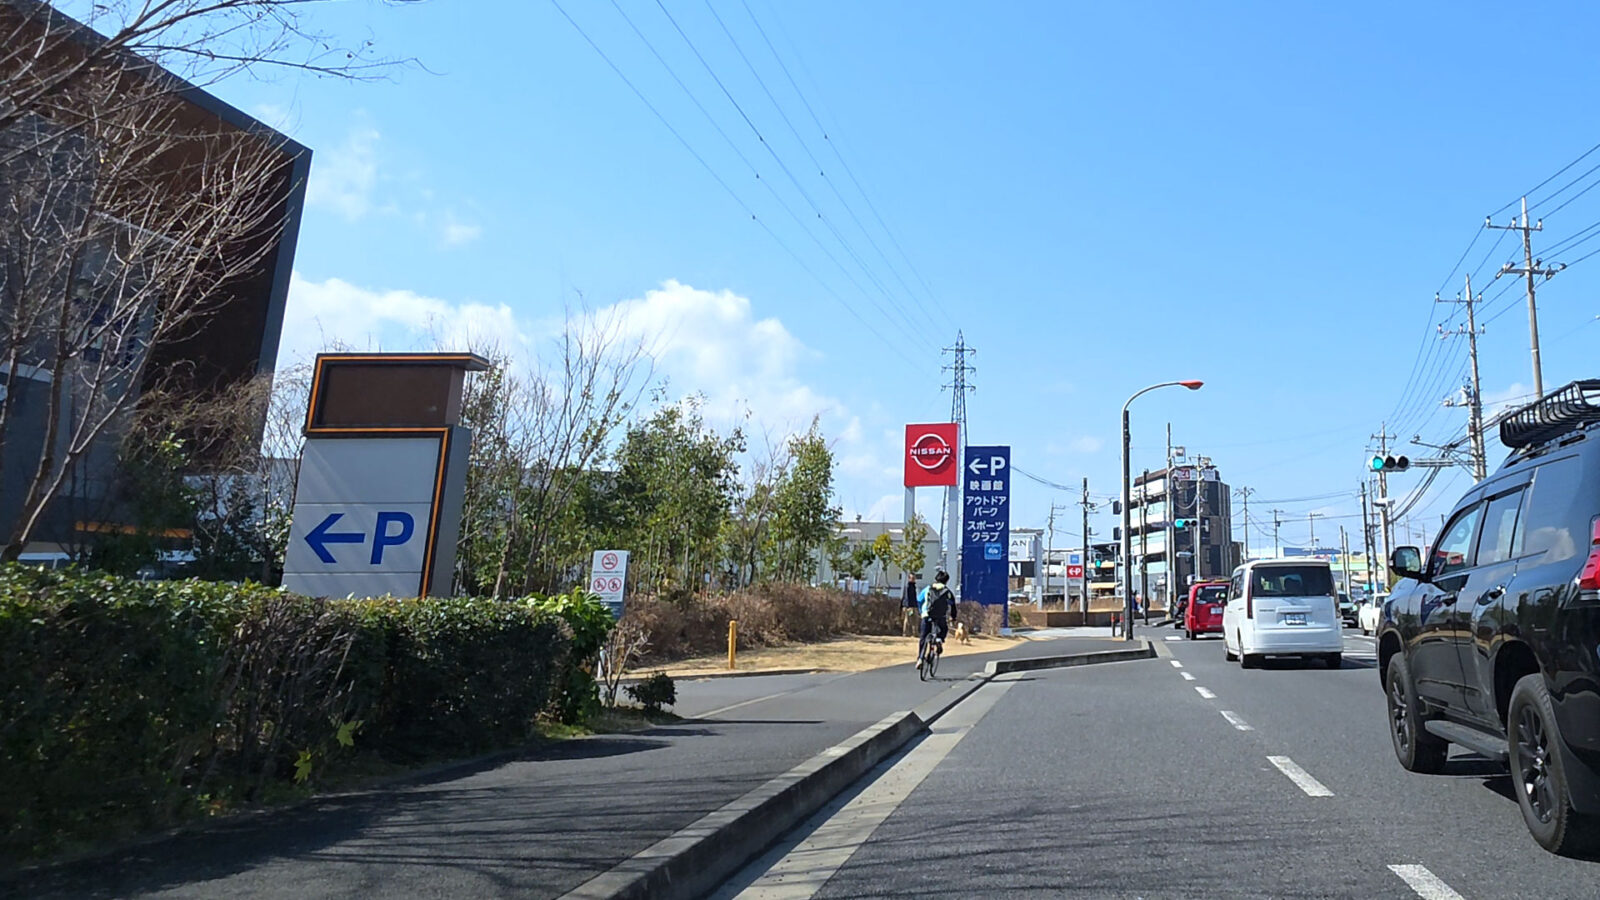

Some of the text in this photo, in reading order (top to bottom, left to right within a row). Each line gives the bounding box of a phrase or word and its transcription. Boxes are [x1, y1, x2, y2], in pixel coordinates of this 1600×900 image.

[910, 447, 951, 456] NISSAN
[990, 456, 1006, 476] P
[969, 480, 1004, 491] 映画館
[966, 496, 1007, 505] アウトドア
[973, 507, 998, 517] パーク
[967, 521, 1004, 530] スポーツ
[370, 512, 414, 565] P
[971, 532, 1000, 542] クラブ
